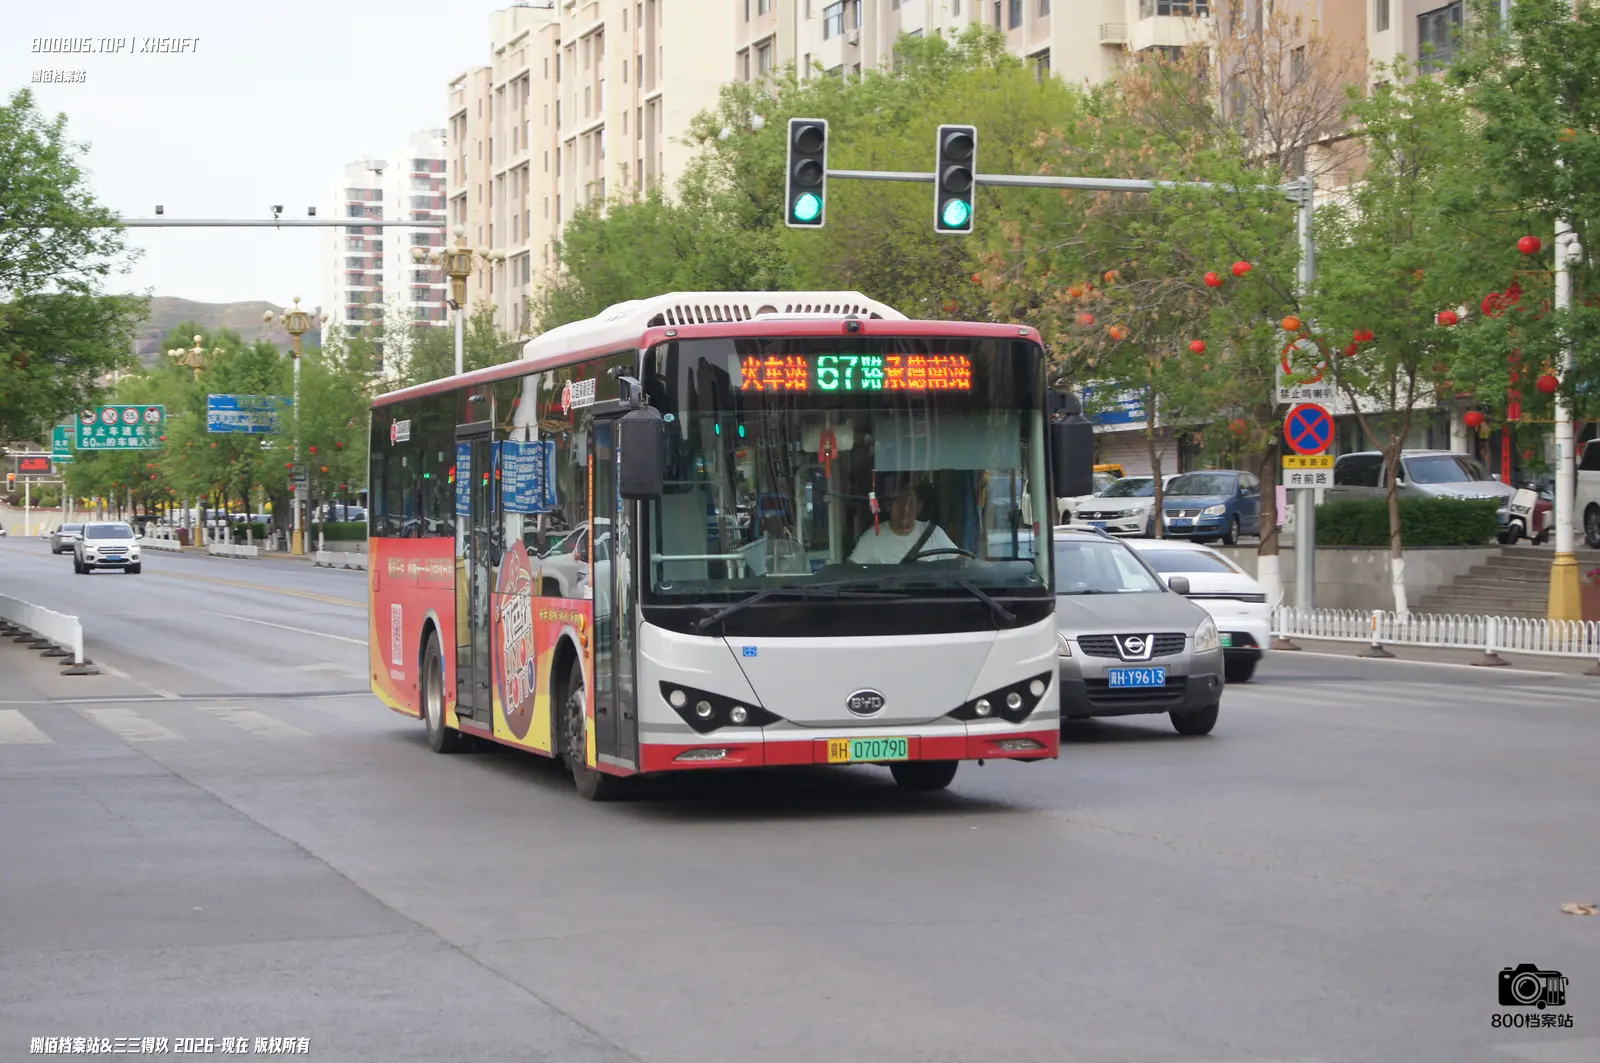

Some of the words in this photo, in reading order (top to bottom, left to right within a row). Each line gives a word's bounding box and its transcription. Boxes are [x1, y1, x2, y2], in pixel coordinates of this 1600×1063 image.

[741, 356, 808, 391] 火车站
[817, 355, 884, 390] 67路
[884, 355, 971, 390] 承德南站
[1280, 388, 1334, 399] 禁止鸣喇叭
[1292, 473, 1327, 485] 府前路
[851, 697, 881, 709] BYD
[854, 740, 906, 758] 07079D
